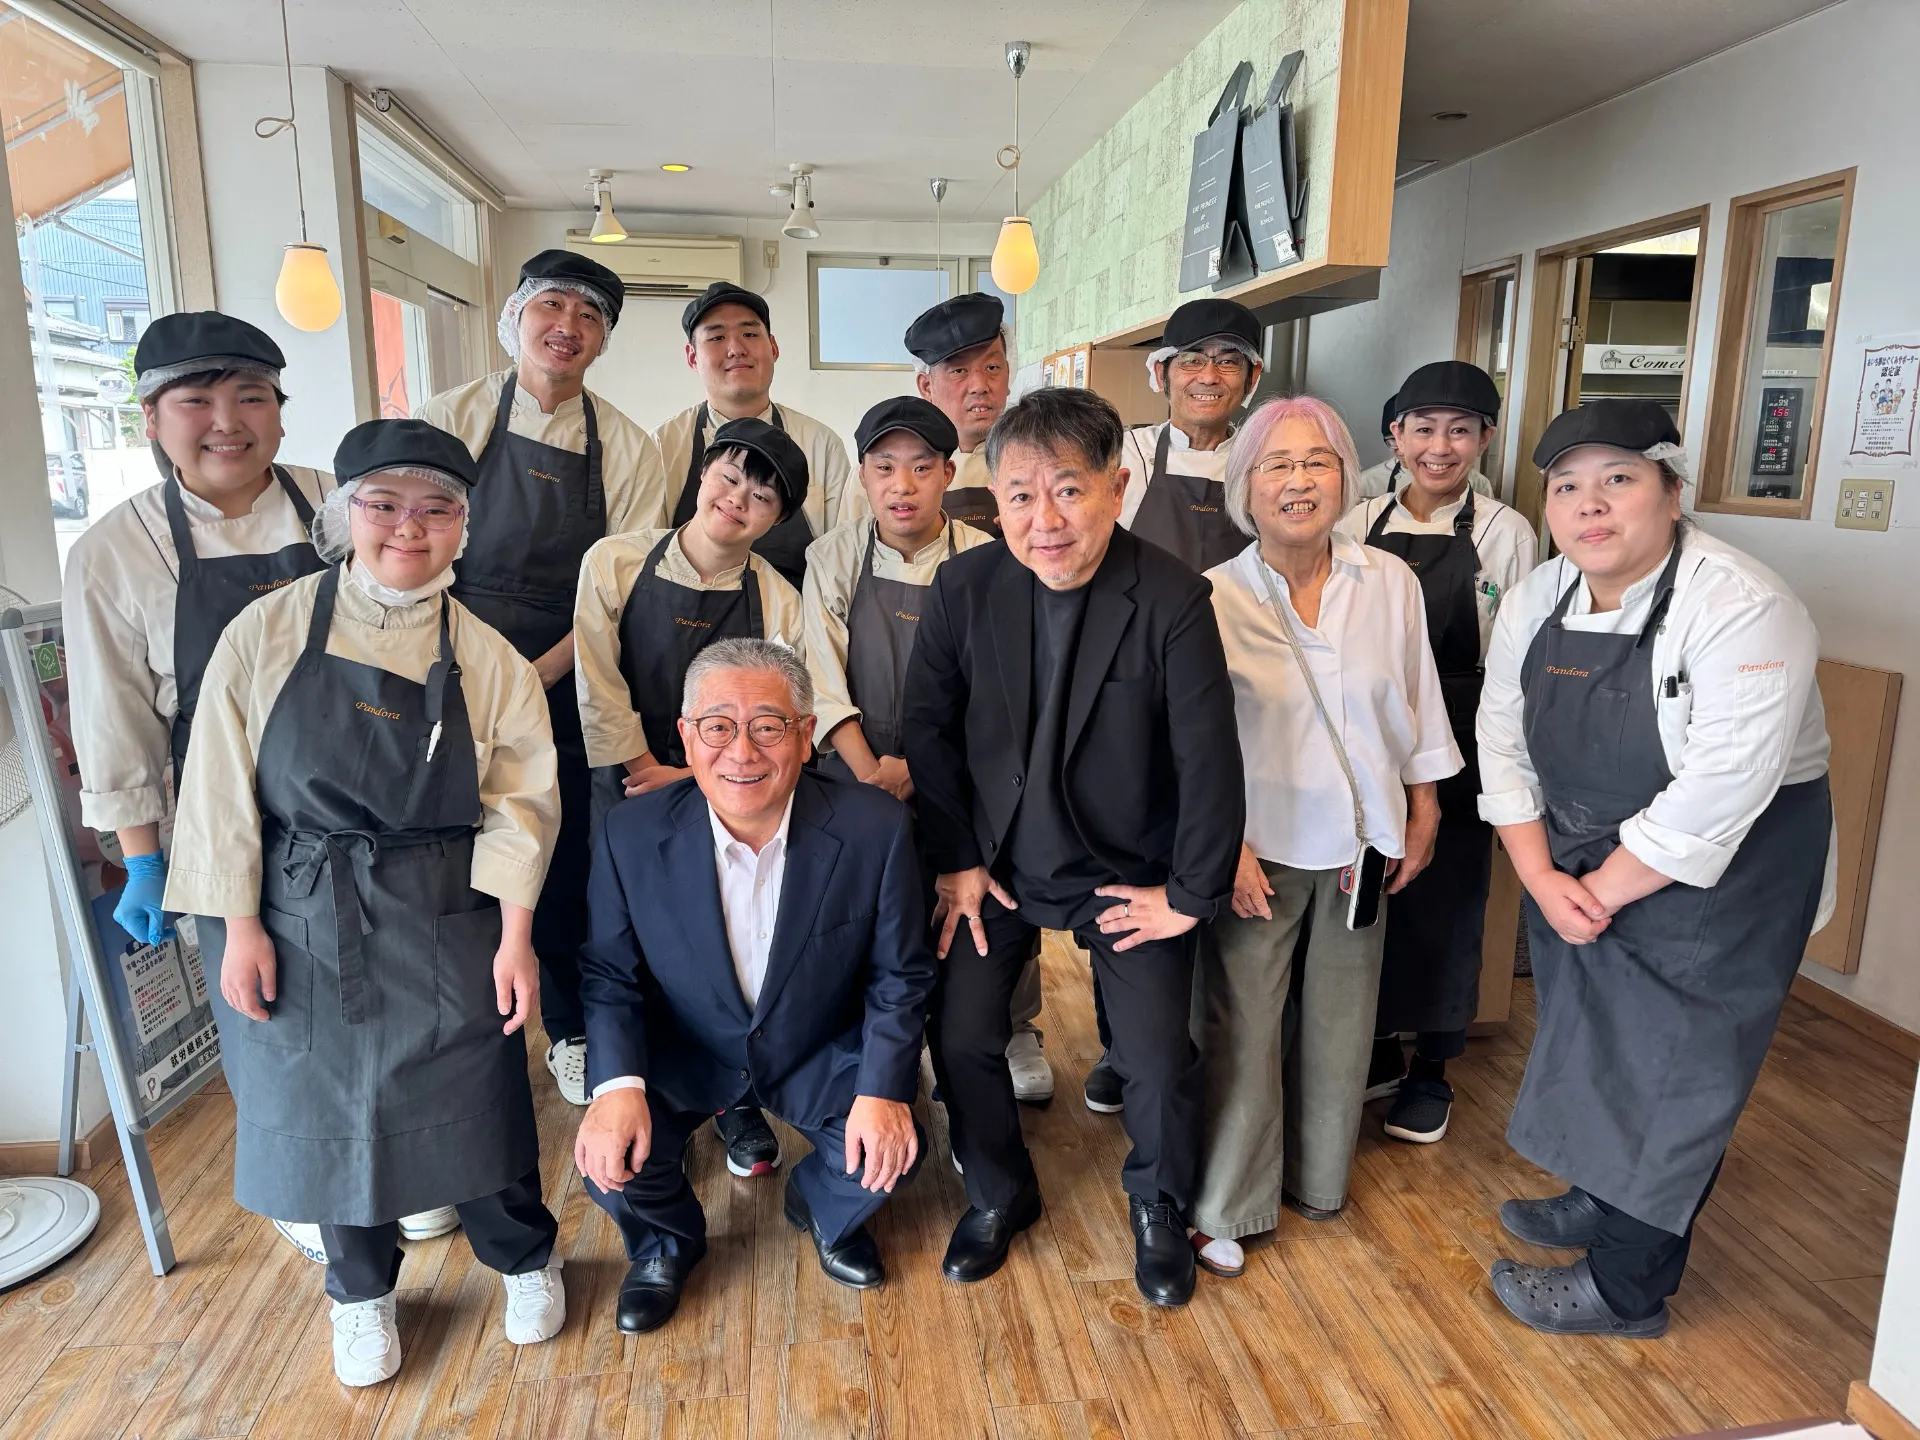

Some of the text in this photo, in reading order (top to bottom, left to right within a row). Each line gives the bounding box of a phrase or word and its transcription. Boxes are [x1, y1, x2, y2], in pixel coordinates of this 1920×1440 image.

[1772, 408, 1789, 417] 156
[527, 468, 560, 483] Pandora
[1190, 504, 1218, 513] Pandora
[248, 579, 292, 591] Pandora
[674, 617, 711, 628] Pandora
[1546, 665, 1589, 678] Pandora
[1737, 660, 1785, 673] Pandora
[355, 701, 401, 720] Pandora
[170, 1023, 219, 1068] 就労継続支援
[295, 1239, 329, 1262] croc
